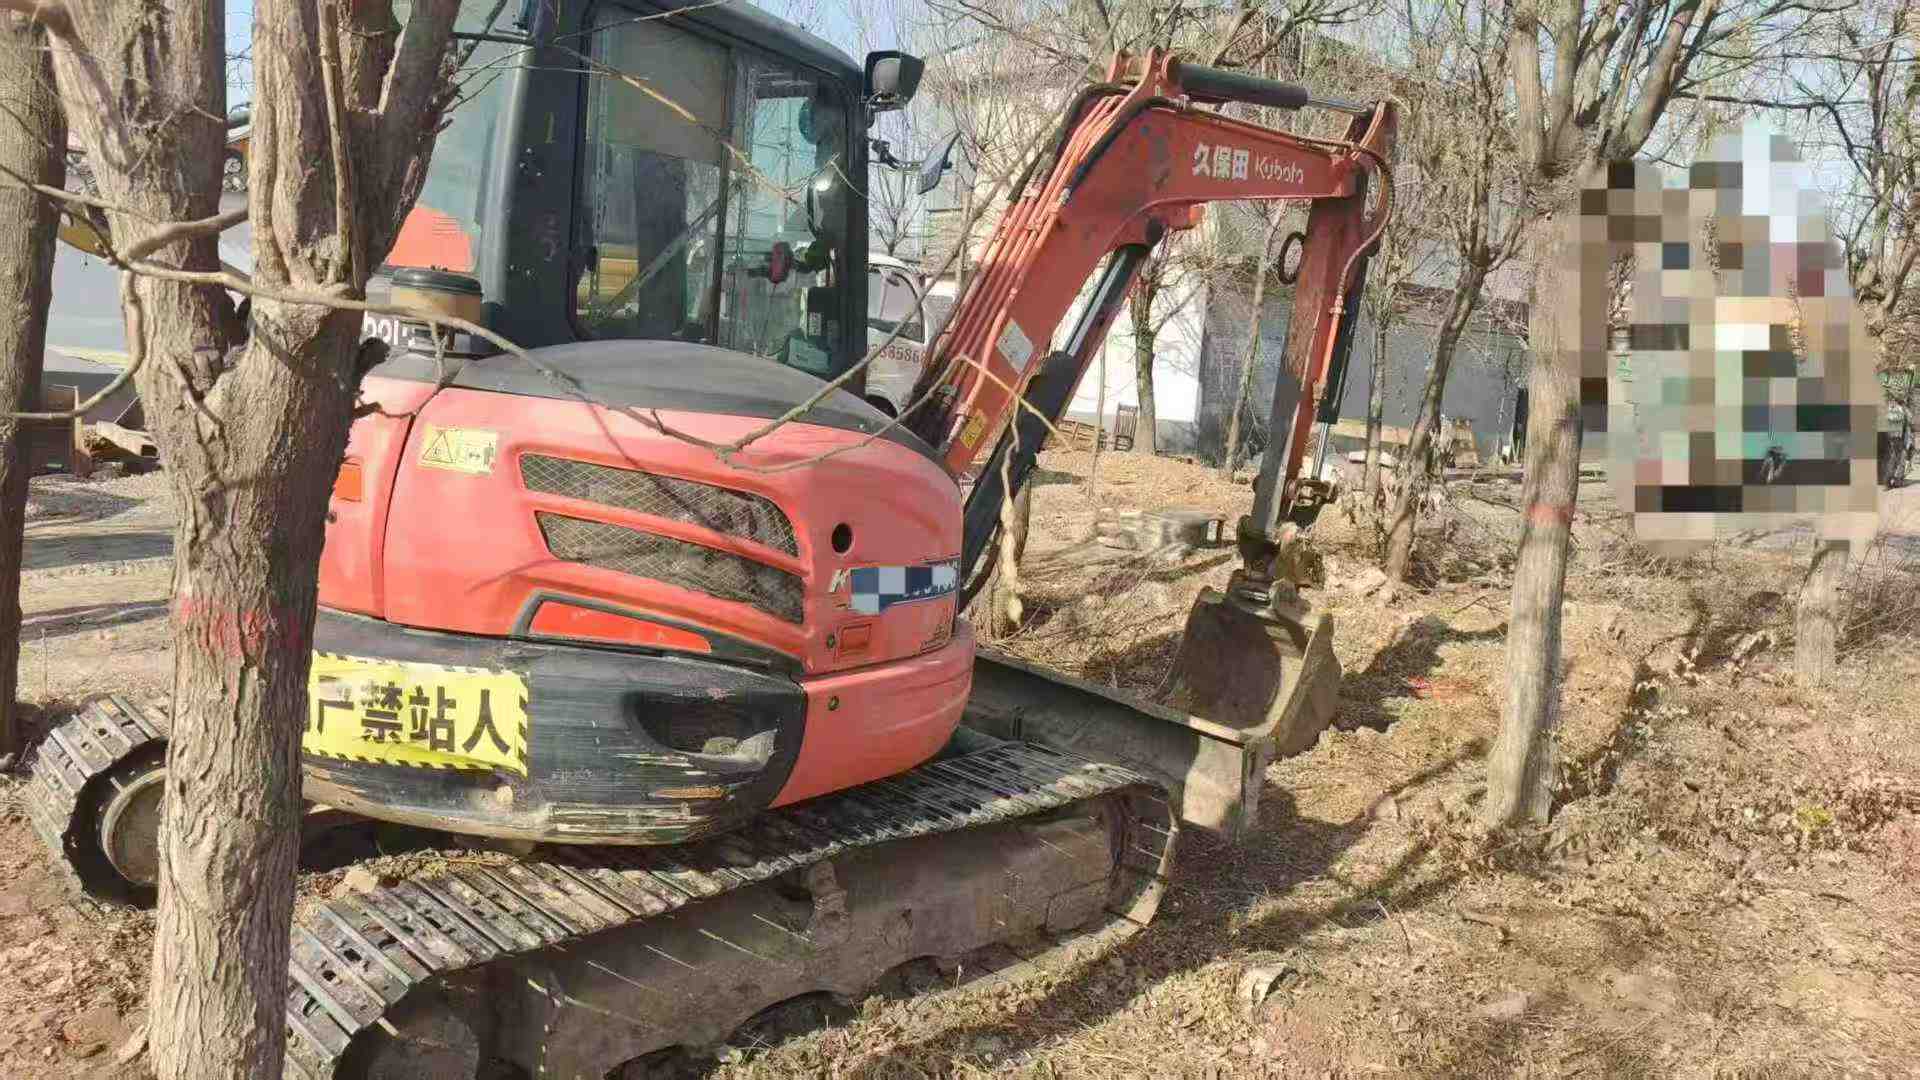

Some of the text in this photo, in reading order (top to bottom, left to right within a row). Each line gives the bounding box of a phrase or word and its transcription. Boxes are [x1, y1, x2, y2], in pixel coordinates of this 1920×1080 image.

[1191, 143, 1304, 184] 久保田 Kubota
[307, 674, 510, 755] 严禁站人
